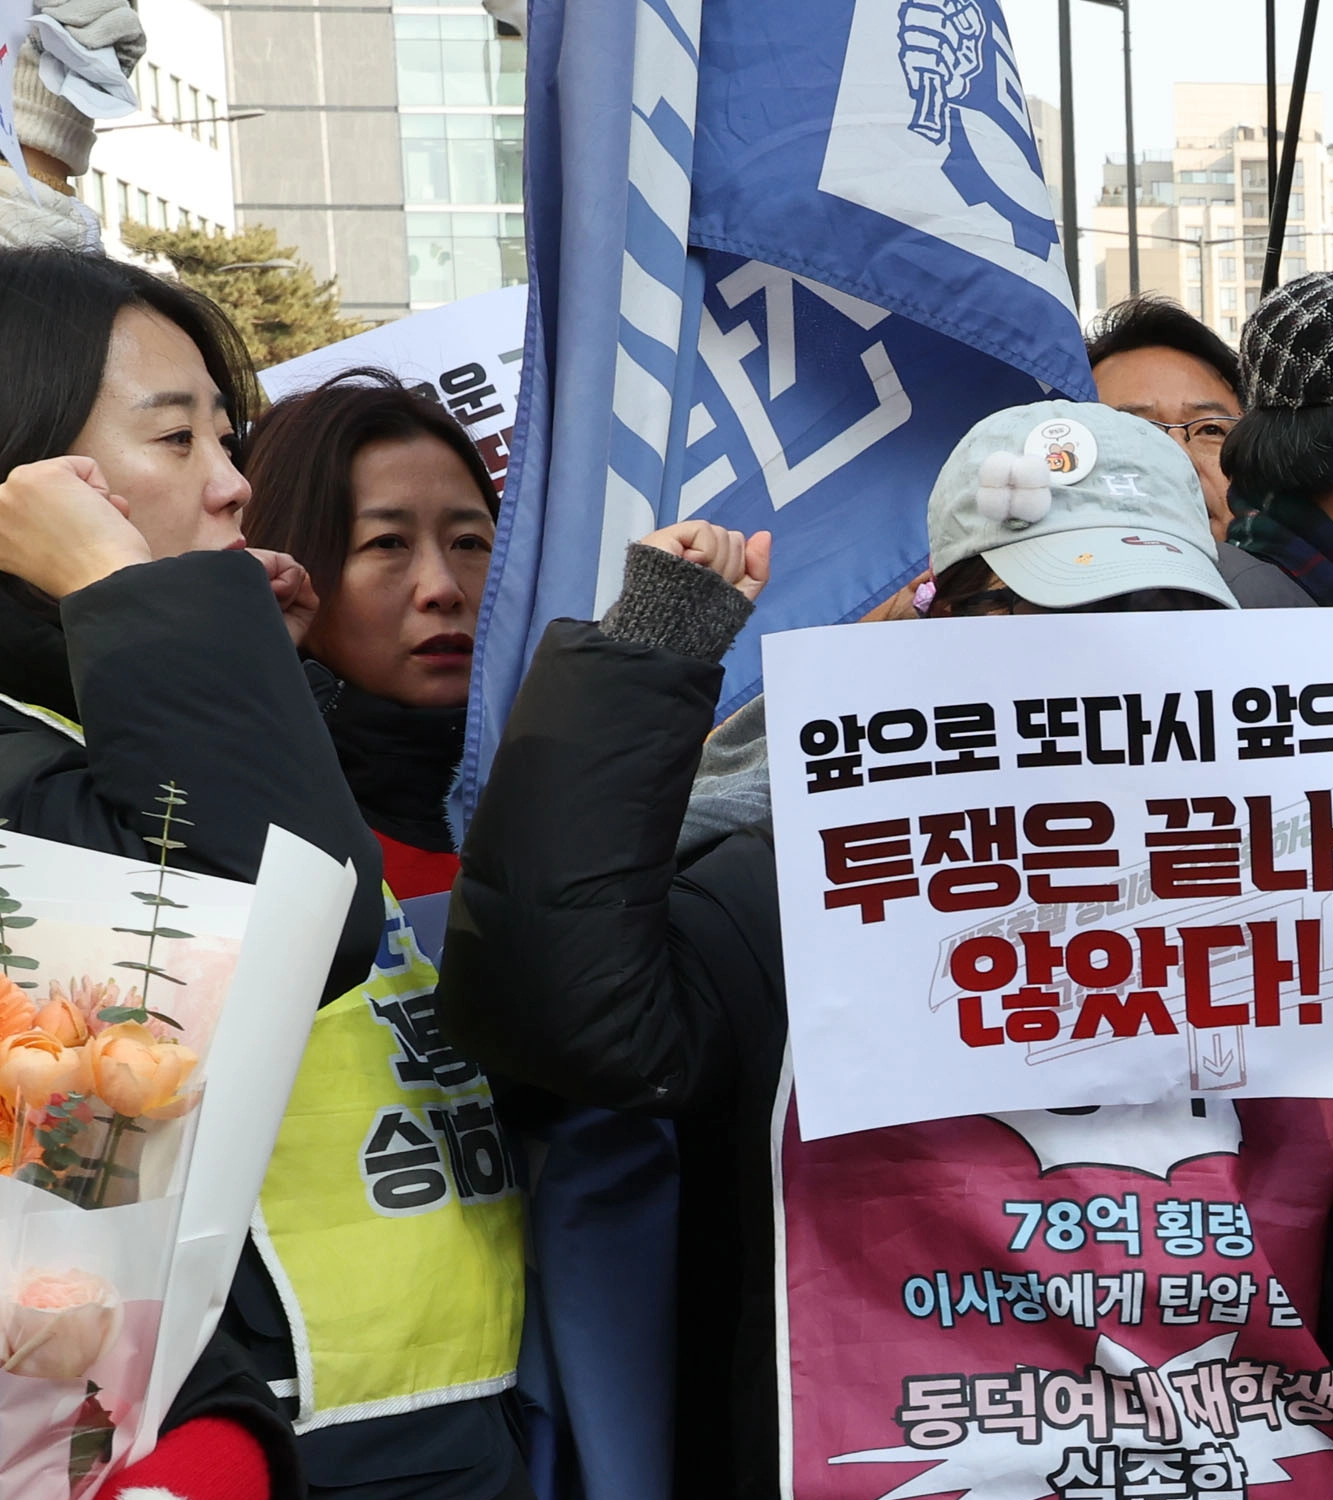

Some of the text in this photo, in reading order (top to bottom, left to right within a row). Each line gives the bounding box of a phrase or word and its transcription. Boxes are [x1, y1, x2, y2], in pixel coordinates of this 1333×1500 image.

[799, 703, 1000, 793] 앞으로
[1014, 689, 1215, 769] 또다시
[819, 800, 1120, 924] 투쟁은
[949, 919, 1323, 1049] 않았다!
[1005, 1195, 1254, 1257] 78억 횡령
[903, 1271, 1144, 1328] 이사장에게
[1160, 1275, 1257, 1326] 탄압
[902, 1369, 1179, 1447] 동덕여대
